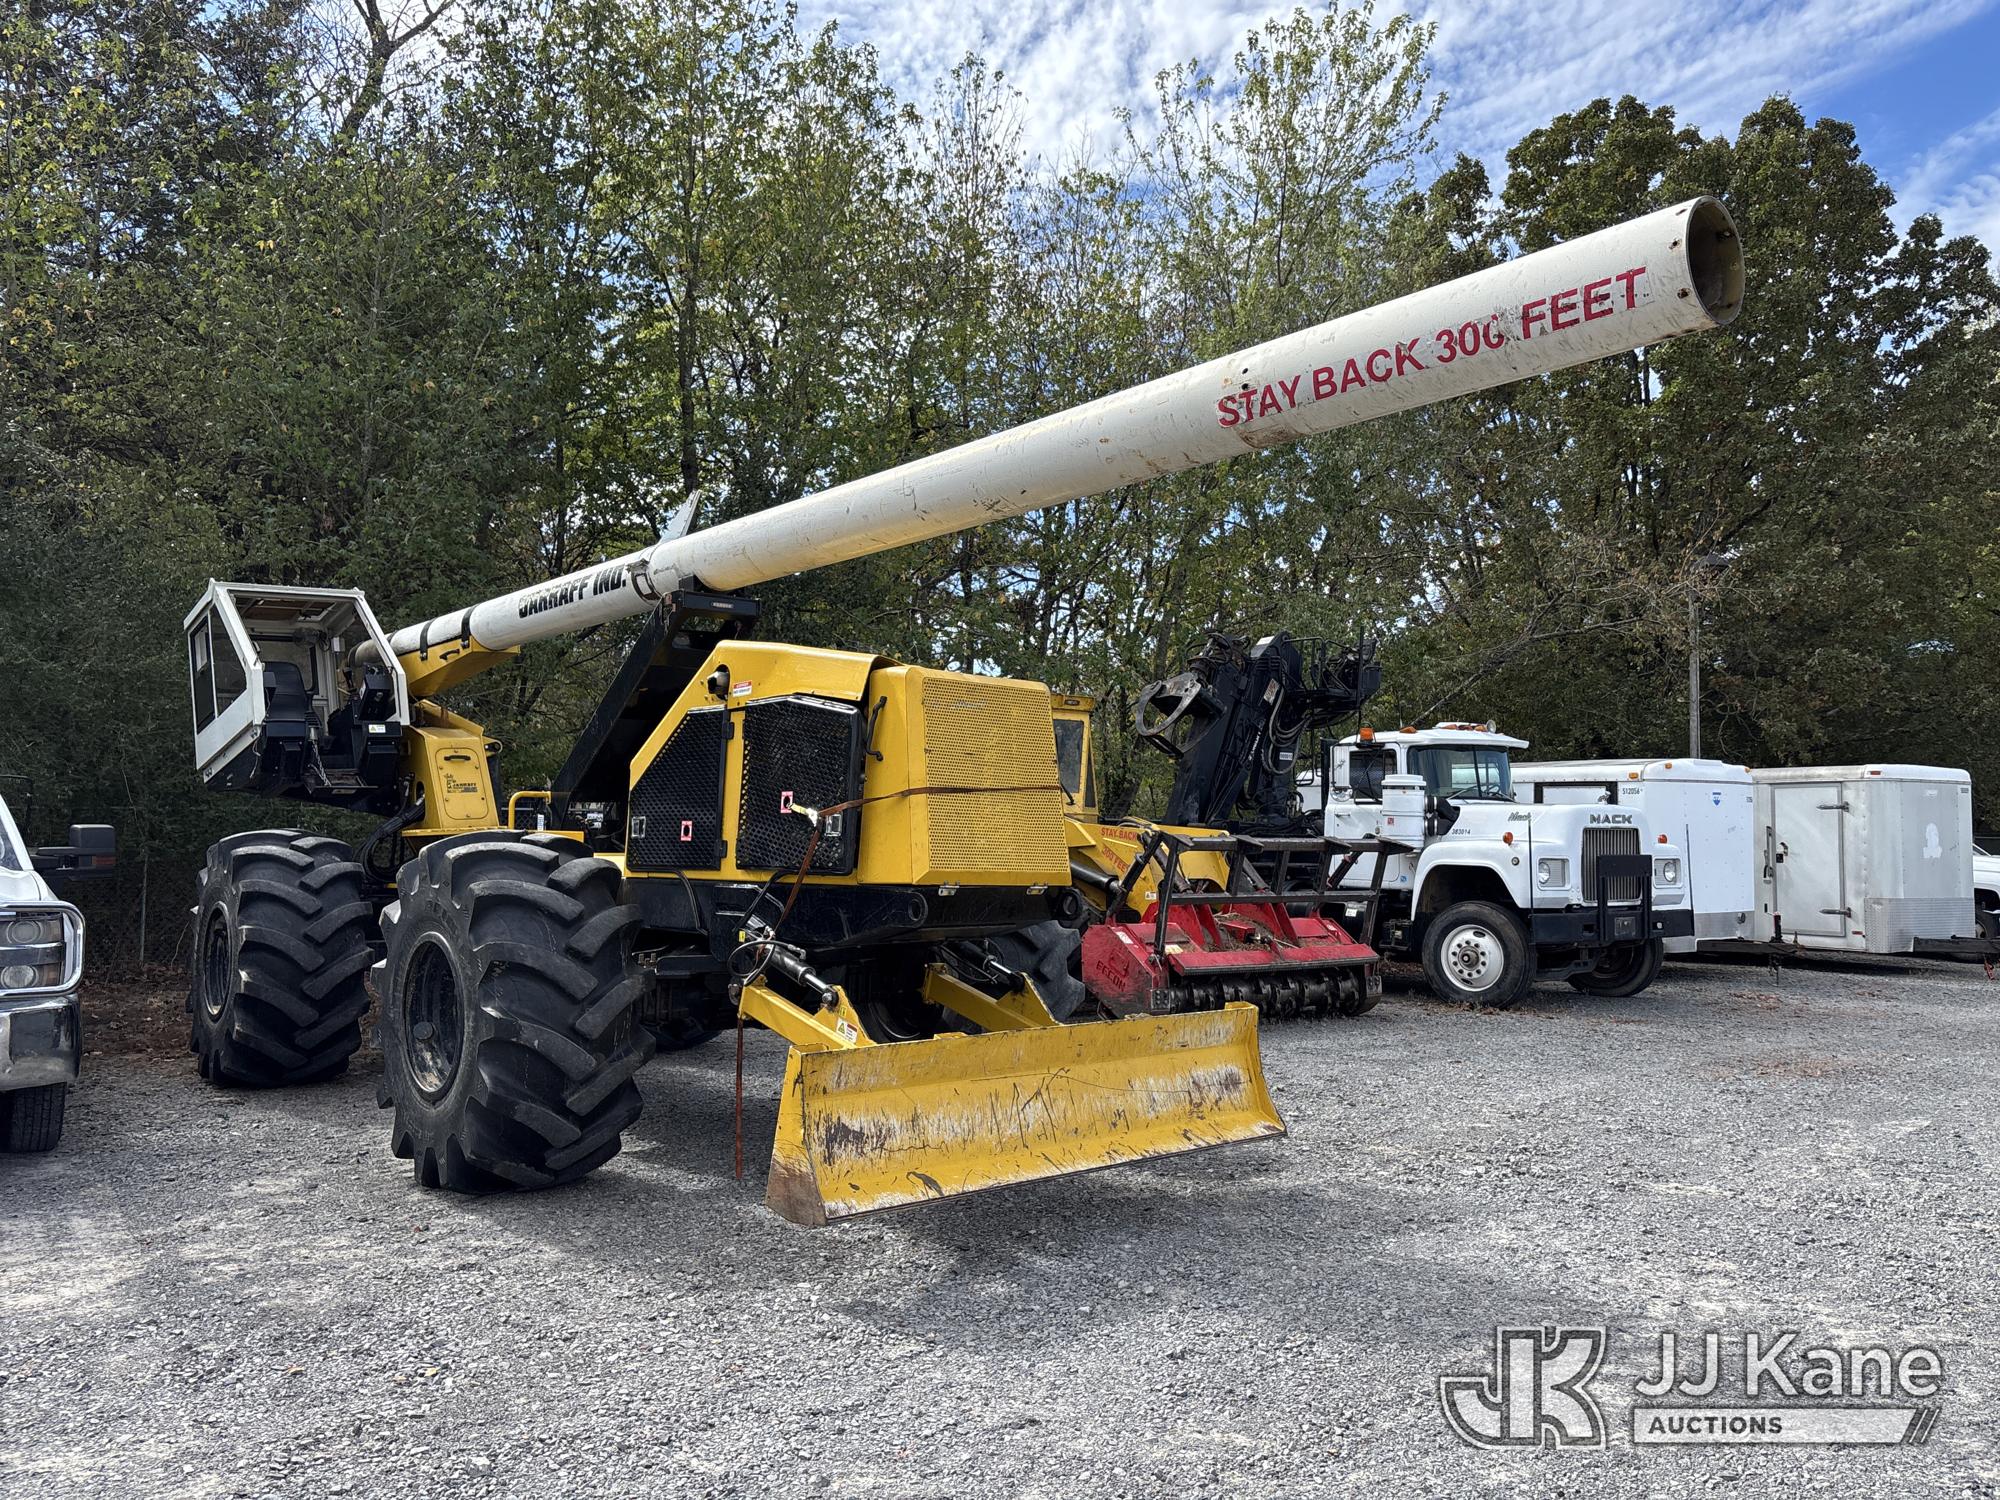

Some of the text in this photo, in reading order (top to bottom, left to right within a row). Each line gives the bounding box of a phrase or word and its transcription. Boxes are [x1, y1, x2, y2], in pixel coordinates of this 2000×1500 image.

[1216, 374, 1301, 427] STAY
[1312, 337, 1430, 401] BACK
[1520, 266, 1647, 340] FEET
[592, 563, 627, 596] IND.
[1589, 814, 1633, 824] MACK
[1101, 827, 1137, 841] STAY BACK
